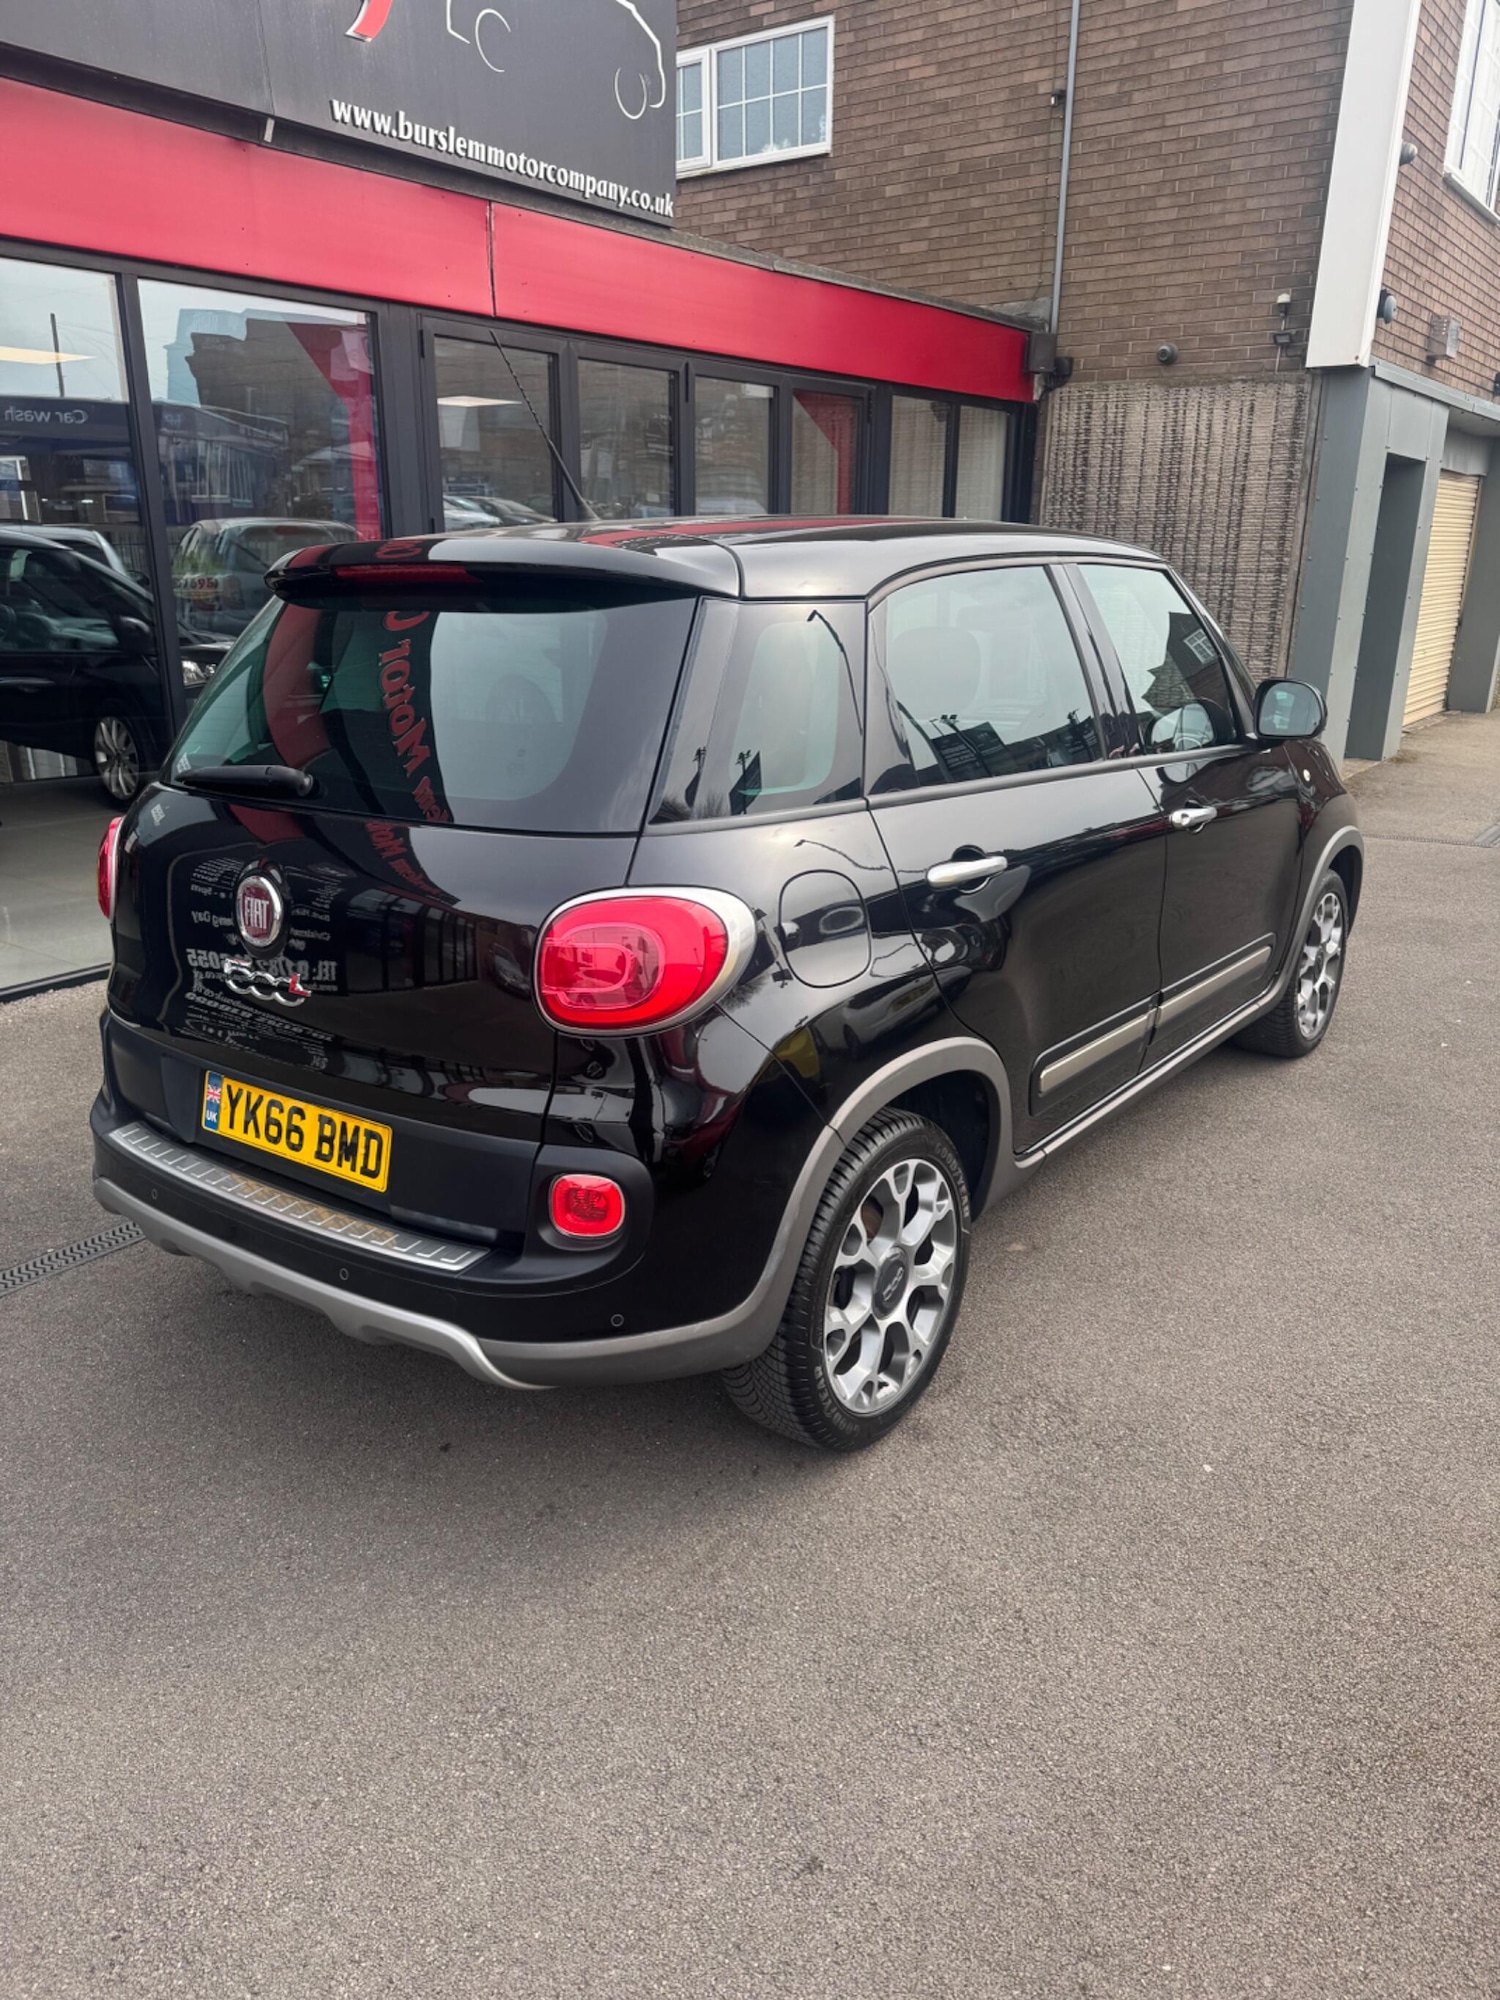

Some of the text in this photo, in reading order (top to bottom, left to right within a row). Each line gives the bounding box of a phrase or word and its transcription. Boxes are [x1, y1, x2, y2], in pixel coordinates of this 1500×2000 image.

[331, 98, 674, 218] www.burslemmotorcompany.co.uk
[244, 896, 269, 930] FIAT
[206, 1110, 217, 1121] UK
[226, 1084, 383, 1179] YK66 BMD
